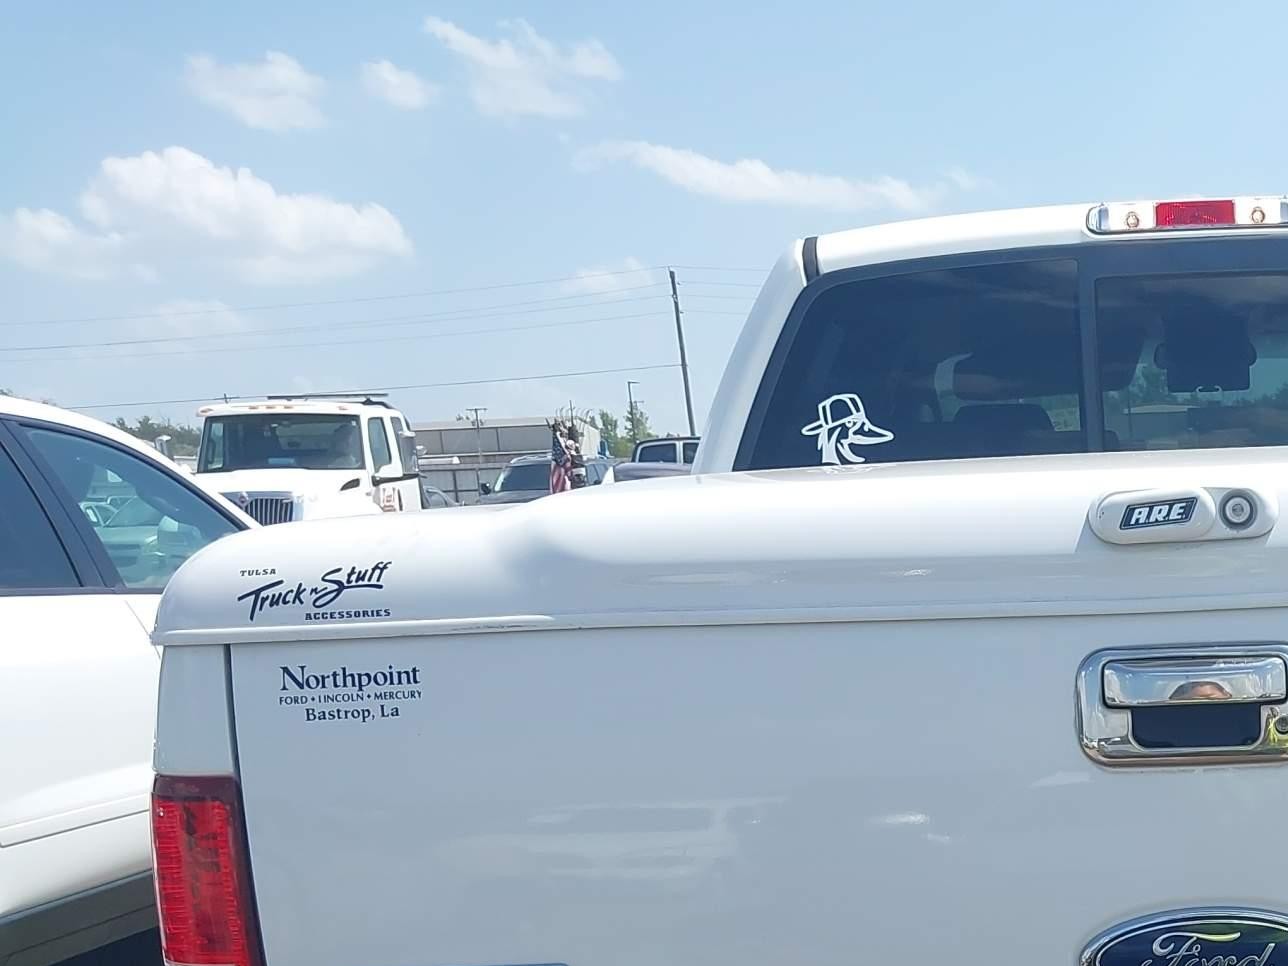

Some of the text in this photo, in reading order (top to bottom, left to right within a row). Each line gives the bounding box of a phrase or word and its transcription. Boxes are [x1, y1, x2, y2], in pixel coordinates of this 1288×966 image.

[239, 568, 277, 577] TULSA
[237, 579, 307, 622] Truck
[312, 561, 392, 609] Stuff
[304, 608, 392, 621] ACCESSORIES
[279, 664, 421, 692] Northpoint
[279, 690, 422, 706] FORD LINCOLN MERCURY
[304, 704, 401, 723] Bastrop, La
